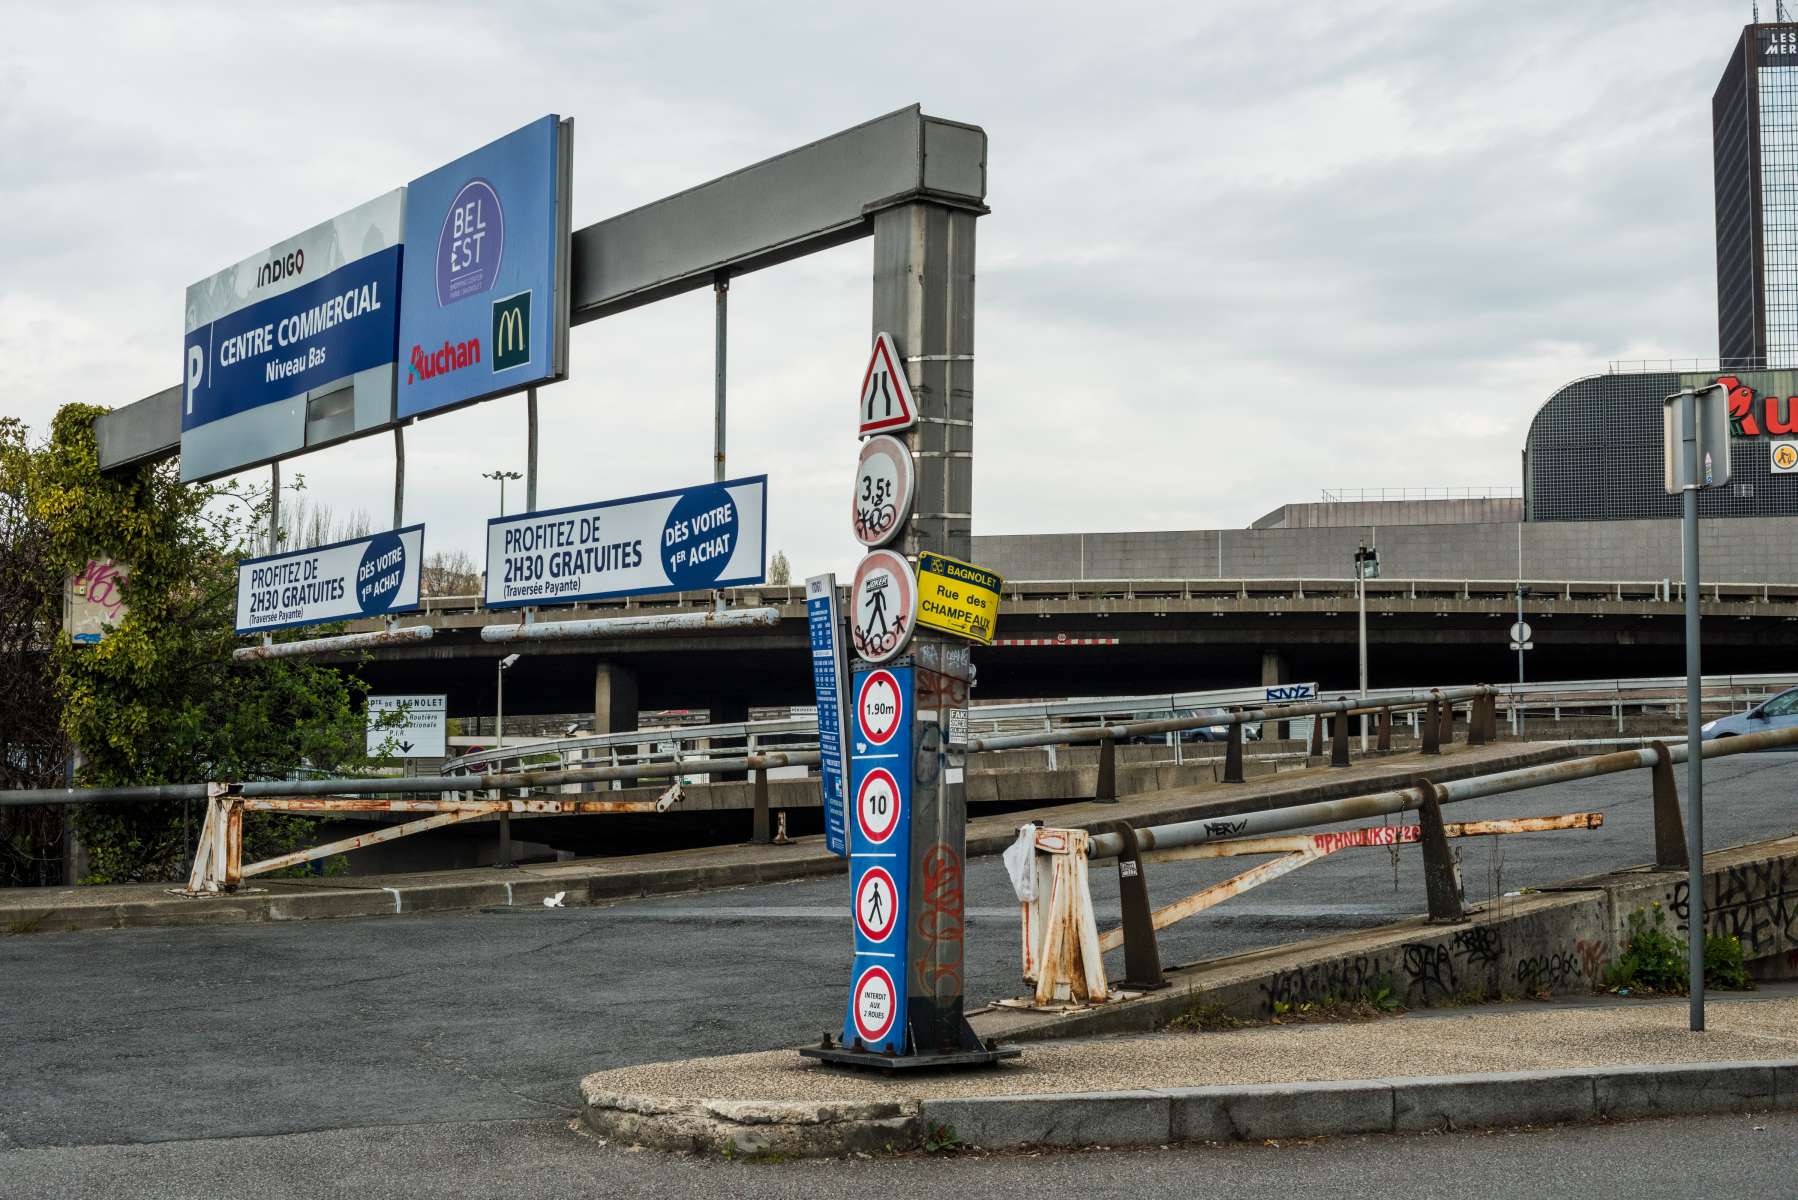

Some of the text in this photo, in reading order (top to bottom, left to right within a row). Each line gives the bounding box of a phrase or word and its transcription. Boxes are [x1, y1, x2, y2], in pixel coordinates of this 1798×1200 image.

[1764, 44, 1797, 55] MER
[1771, 33, 1797, 43] LES
[453, 199, 486, 239] BEL
[257, 248, 304, 288] INDIGO
[451, 231, 485, 273] EST
[220, 281, 381, 367] CENTRE COMMERCIAL
[265, 346, 326, 383] Niveau Bas
[407, 337, 481, 385] Auchan
[186, 344, 204, 415] P
[505, 516, 600, 554] PROFITEZ DE
[665, 503, 732, 547] DÈS VOTRE
[359, 546, 402, 582] DÈS VOTRE
[504, 539, 642, 583] 2H30 GRATUITES
[689, 533, 731, 567] ACHAT
[252, 558, 318, 590] PROFITEZ DE
[373, 570, 401, 597] ACHAT
[503, 576, 581, 599] (Traversée Payante)
[947, 565, 996, 588] BAGNOLET
[250, 577, 345, 613] 2H30 GRATUITES
[936, 584, 986, 609] Rue des
[249, 607, 304, 625] (Traversée Payante)
[922, 600, 991, 630] CHAMPEAUX
[396, 699, 443, 707] BAGNOLET
[866, 702, 894, 715] 1.90m
[869, 795, 887, 815] 10
[864, 992, 887, 1000] INTERDIT
[868, 1011, 884, 1019] ROUES
